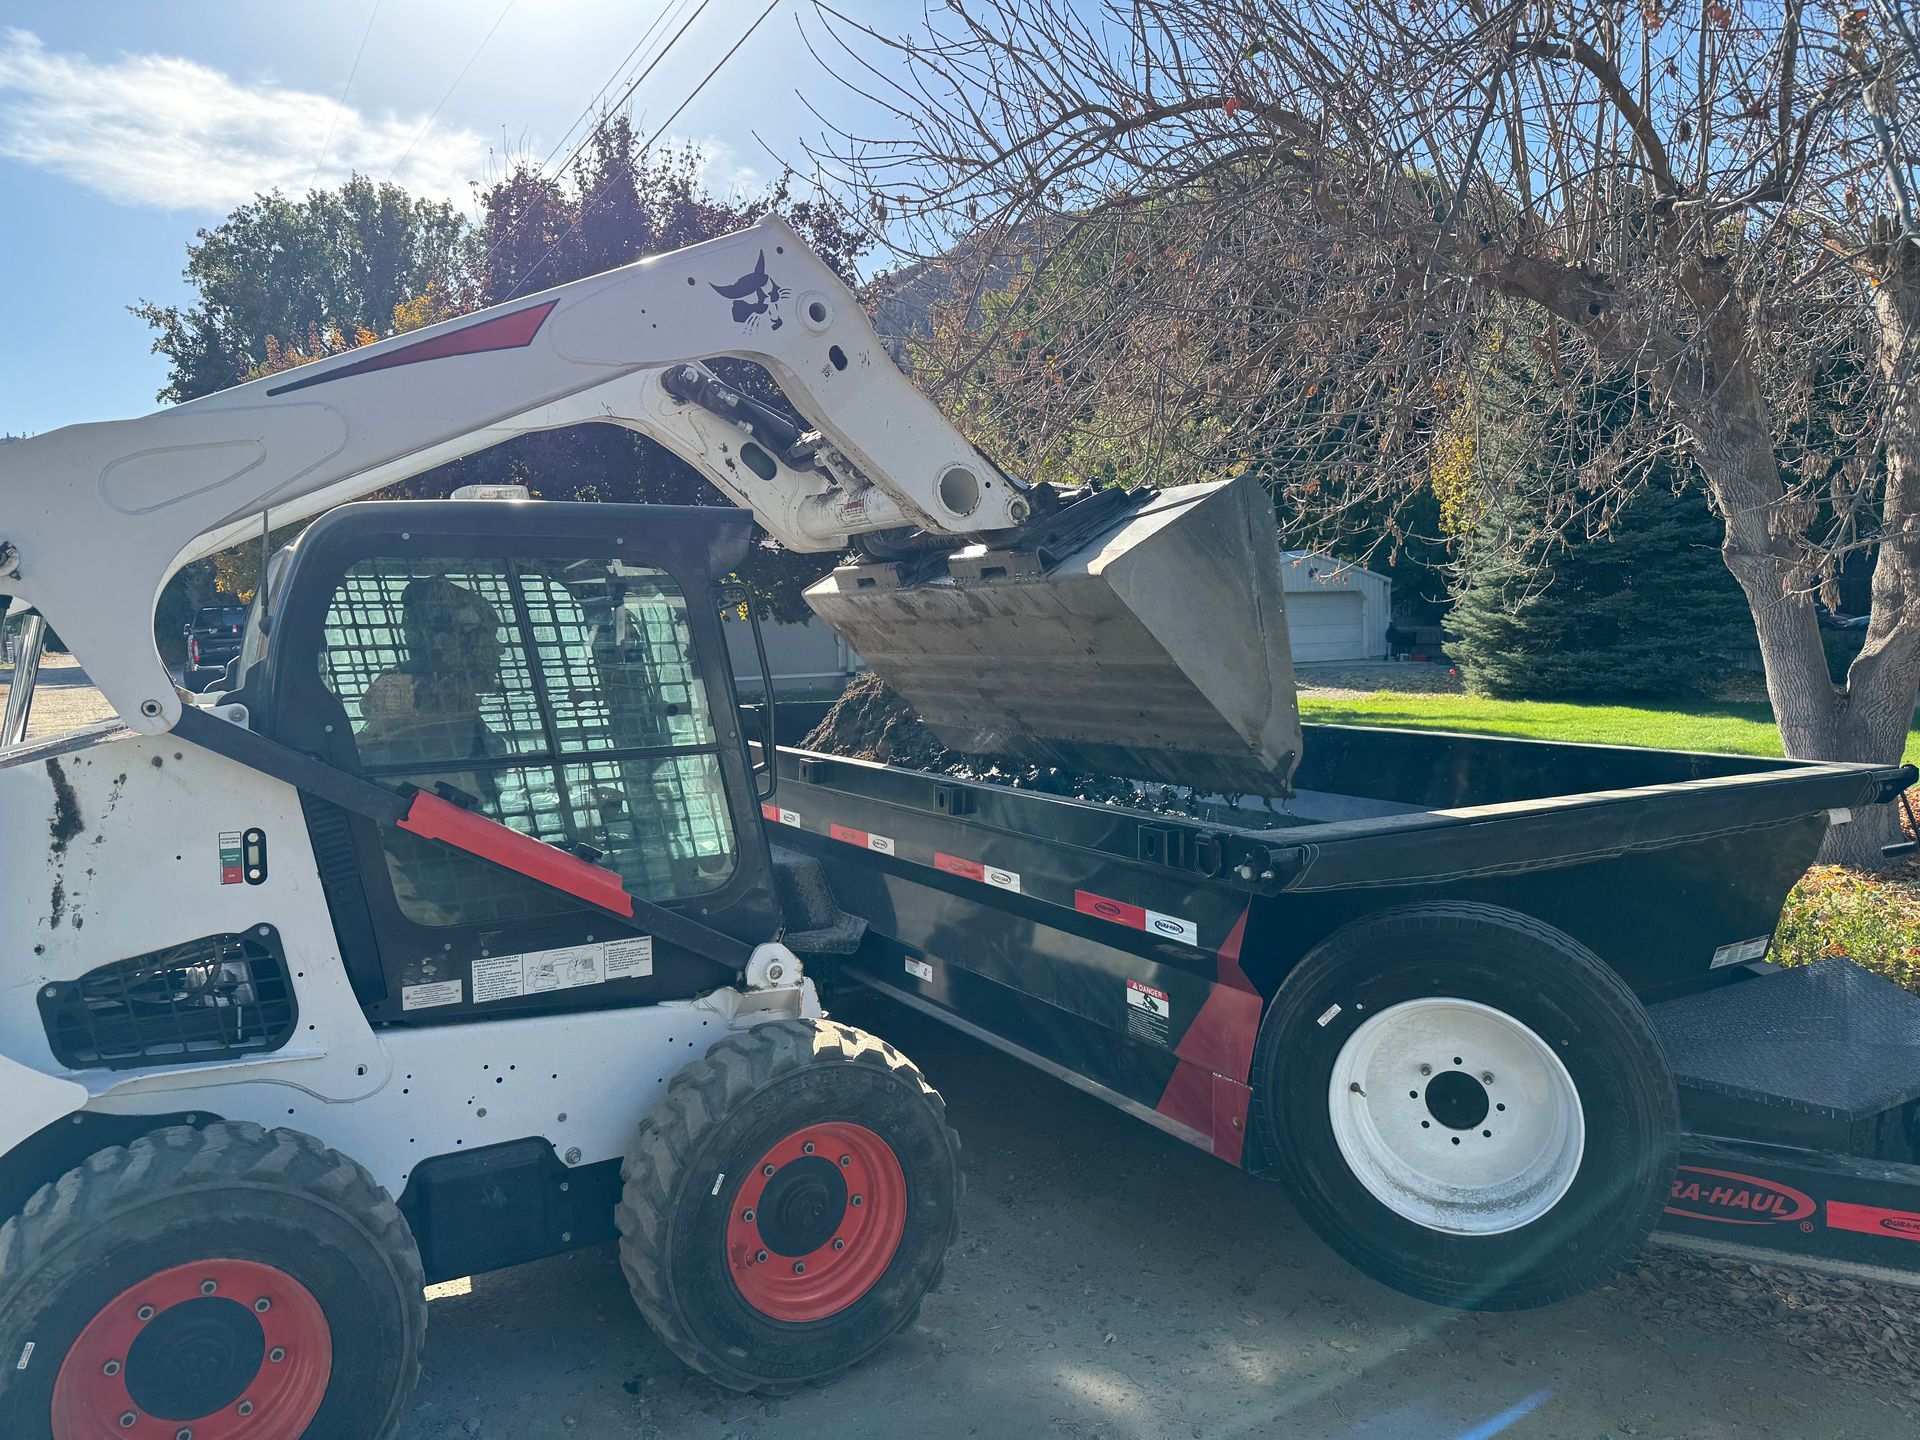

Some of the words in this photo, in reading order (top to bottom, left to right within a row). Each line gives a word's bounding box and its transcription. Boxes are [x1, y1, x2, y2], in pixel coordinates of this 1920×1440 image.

[1157, 921, 1181, 933] DURA-HAUL
[1138, 984, 1162, 998] DANGER
[1671, 1180, 1788, 1215] RA-HAUL
[1886, 1218, 1920, 1230] DURA-H
